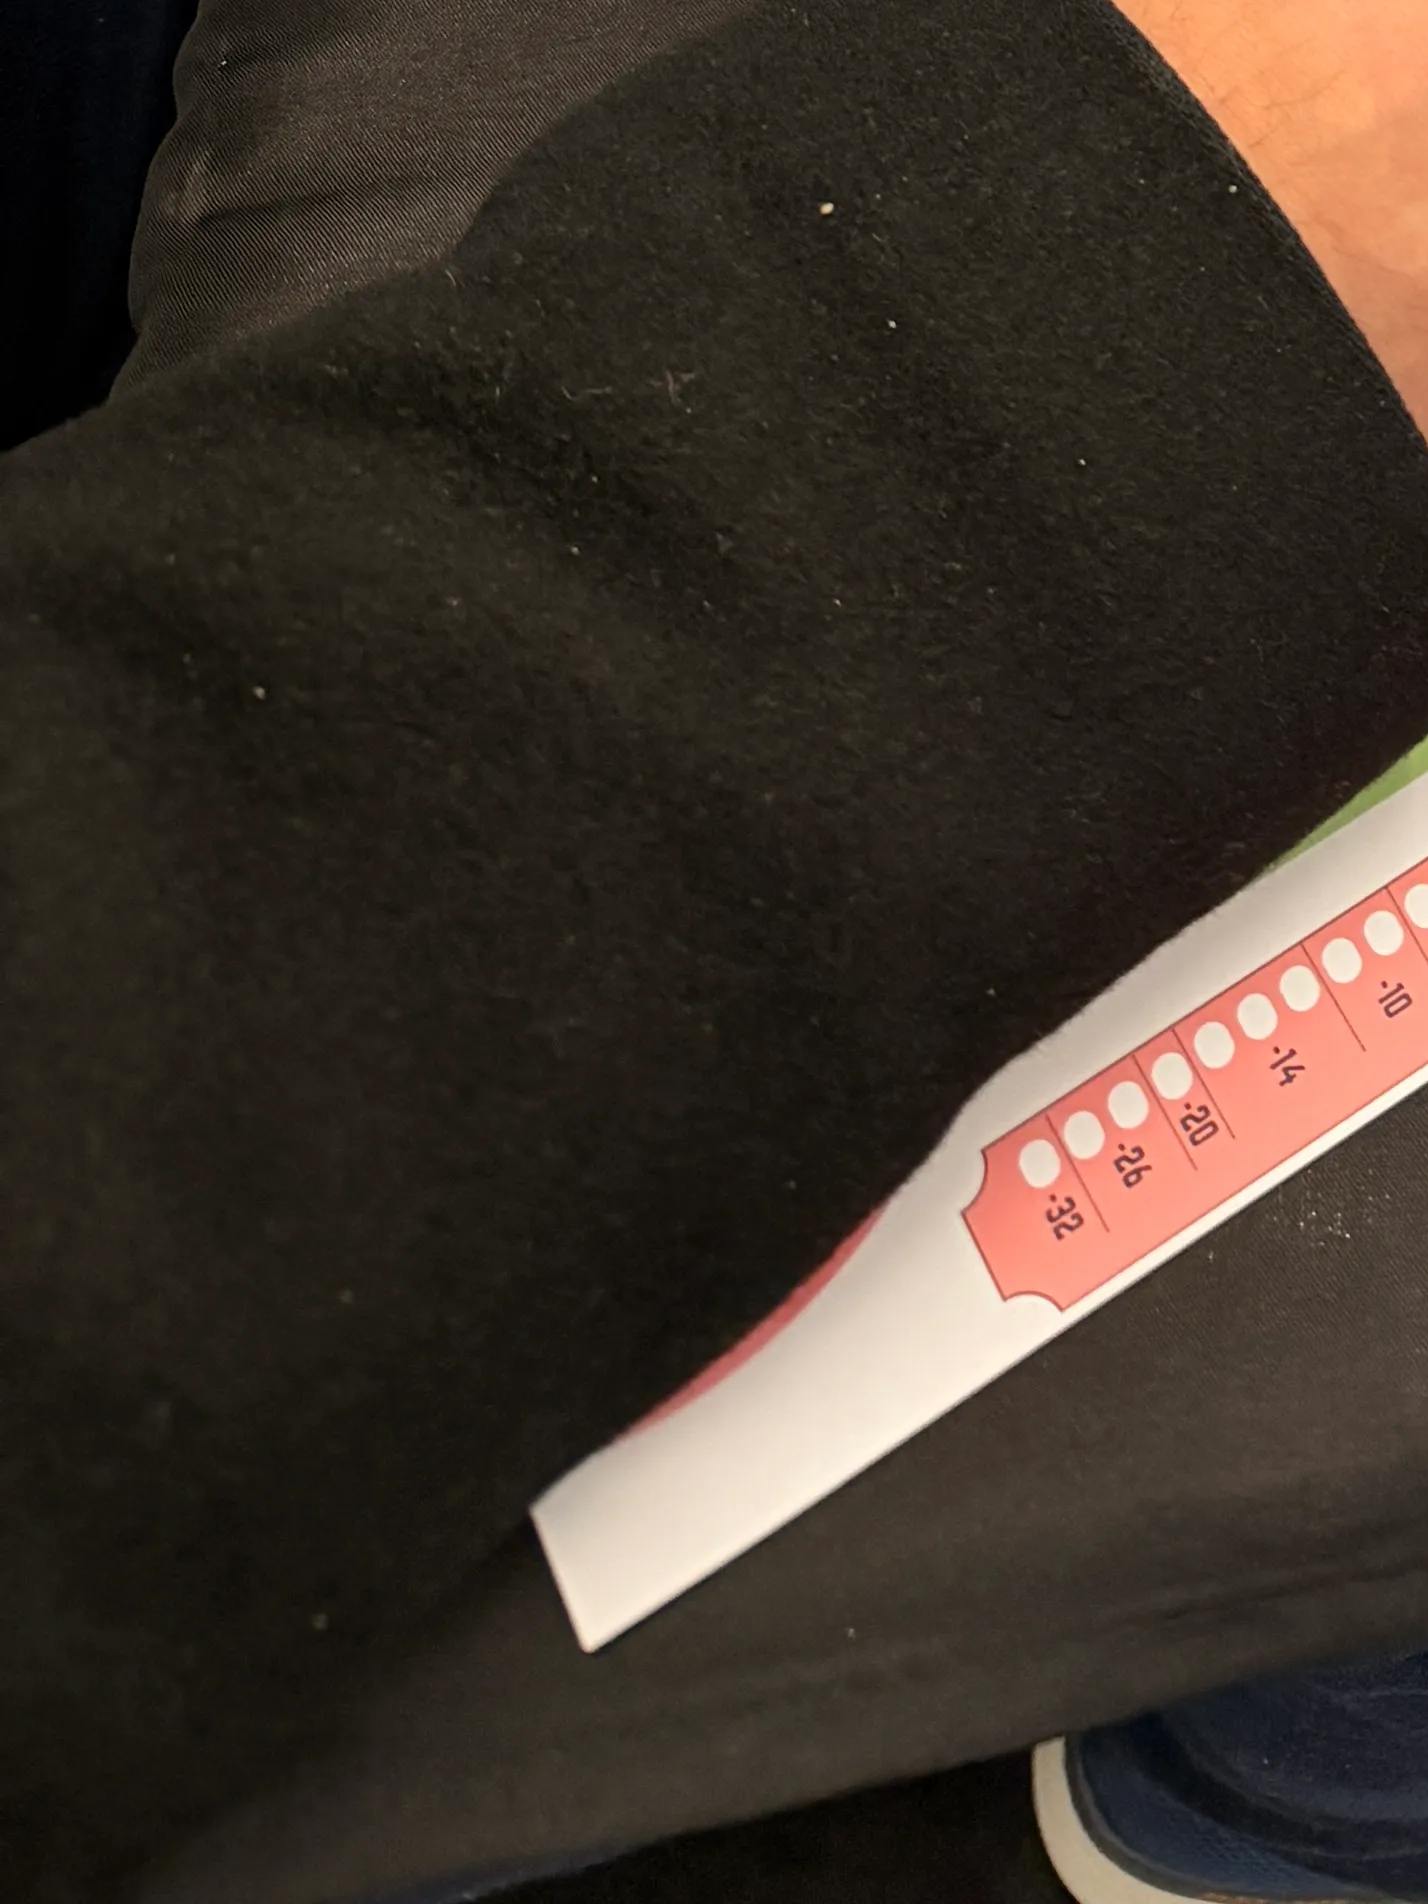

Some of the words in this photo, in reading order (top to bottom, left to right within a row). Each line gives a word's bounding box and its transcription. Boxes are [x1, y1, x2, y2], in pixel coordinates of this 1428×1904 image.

[1378, 980, 1413, 1019] -10
[1270, 1046, 1306, 1088] -14
[1183, 1101, 1220, 1148] -20
[1114, 1142, 1153, 1189] -26
[1046, 1193, 1084, 1240] -32
